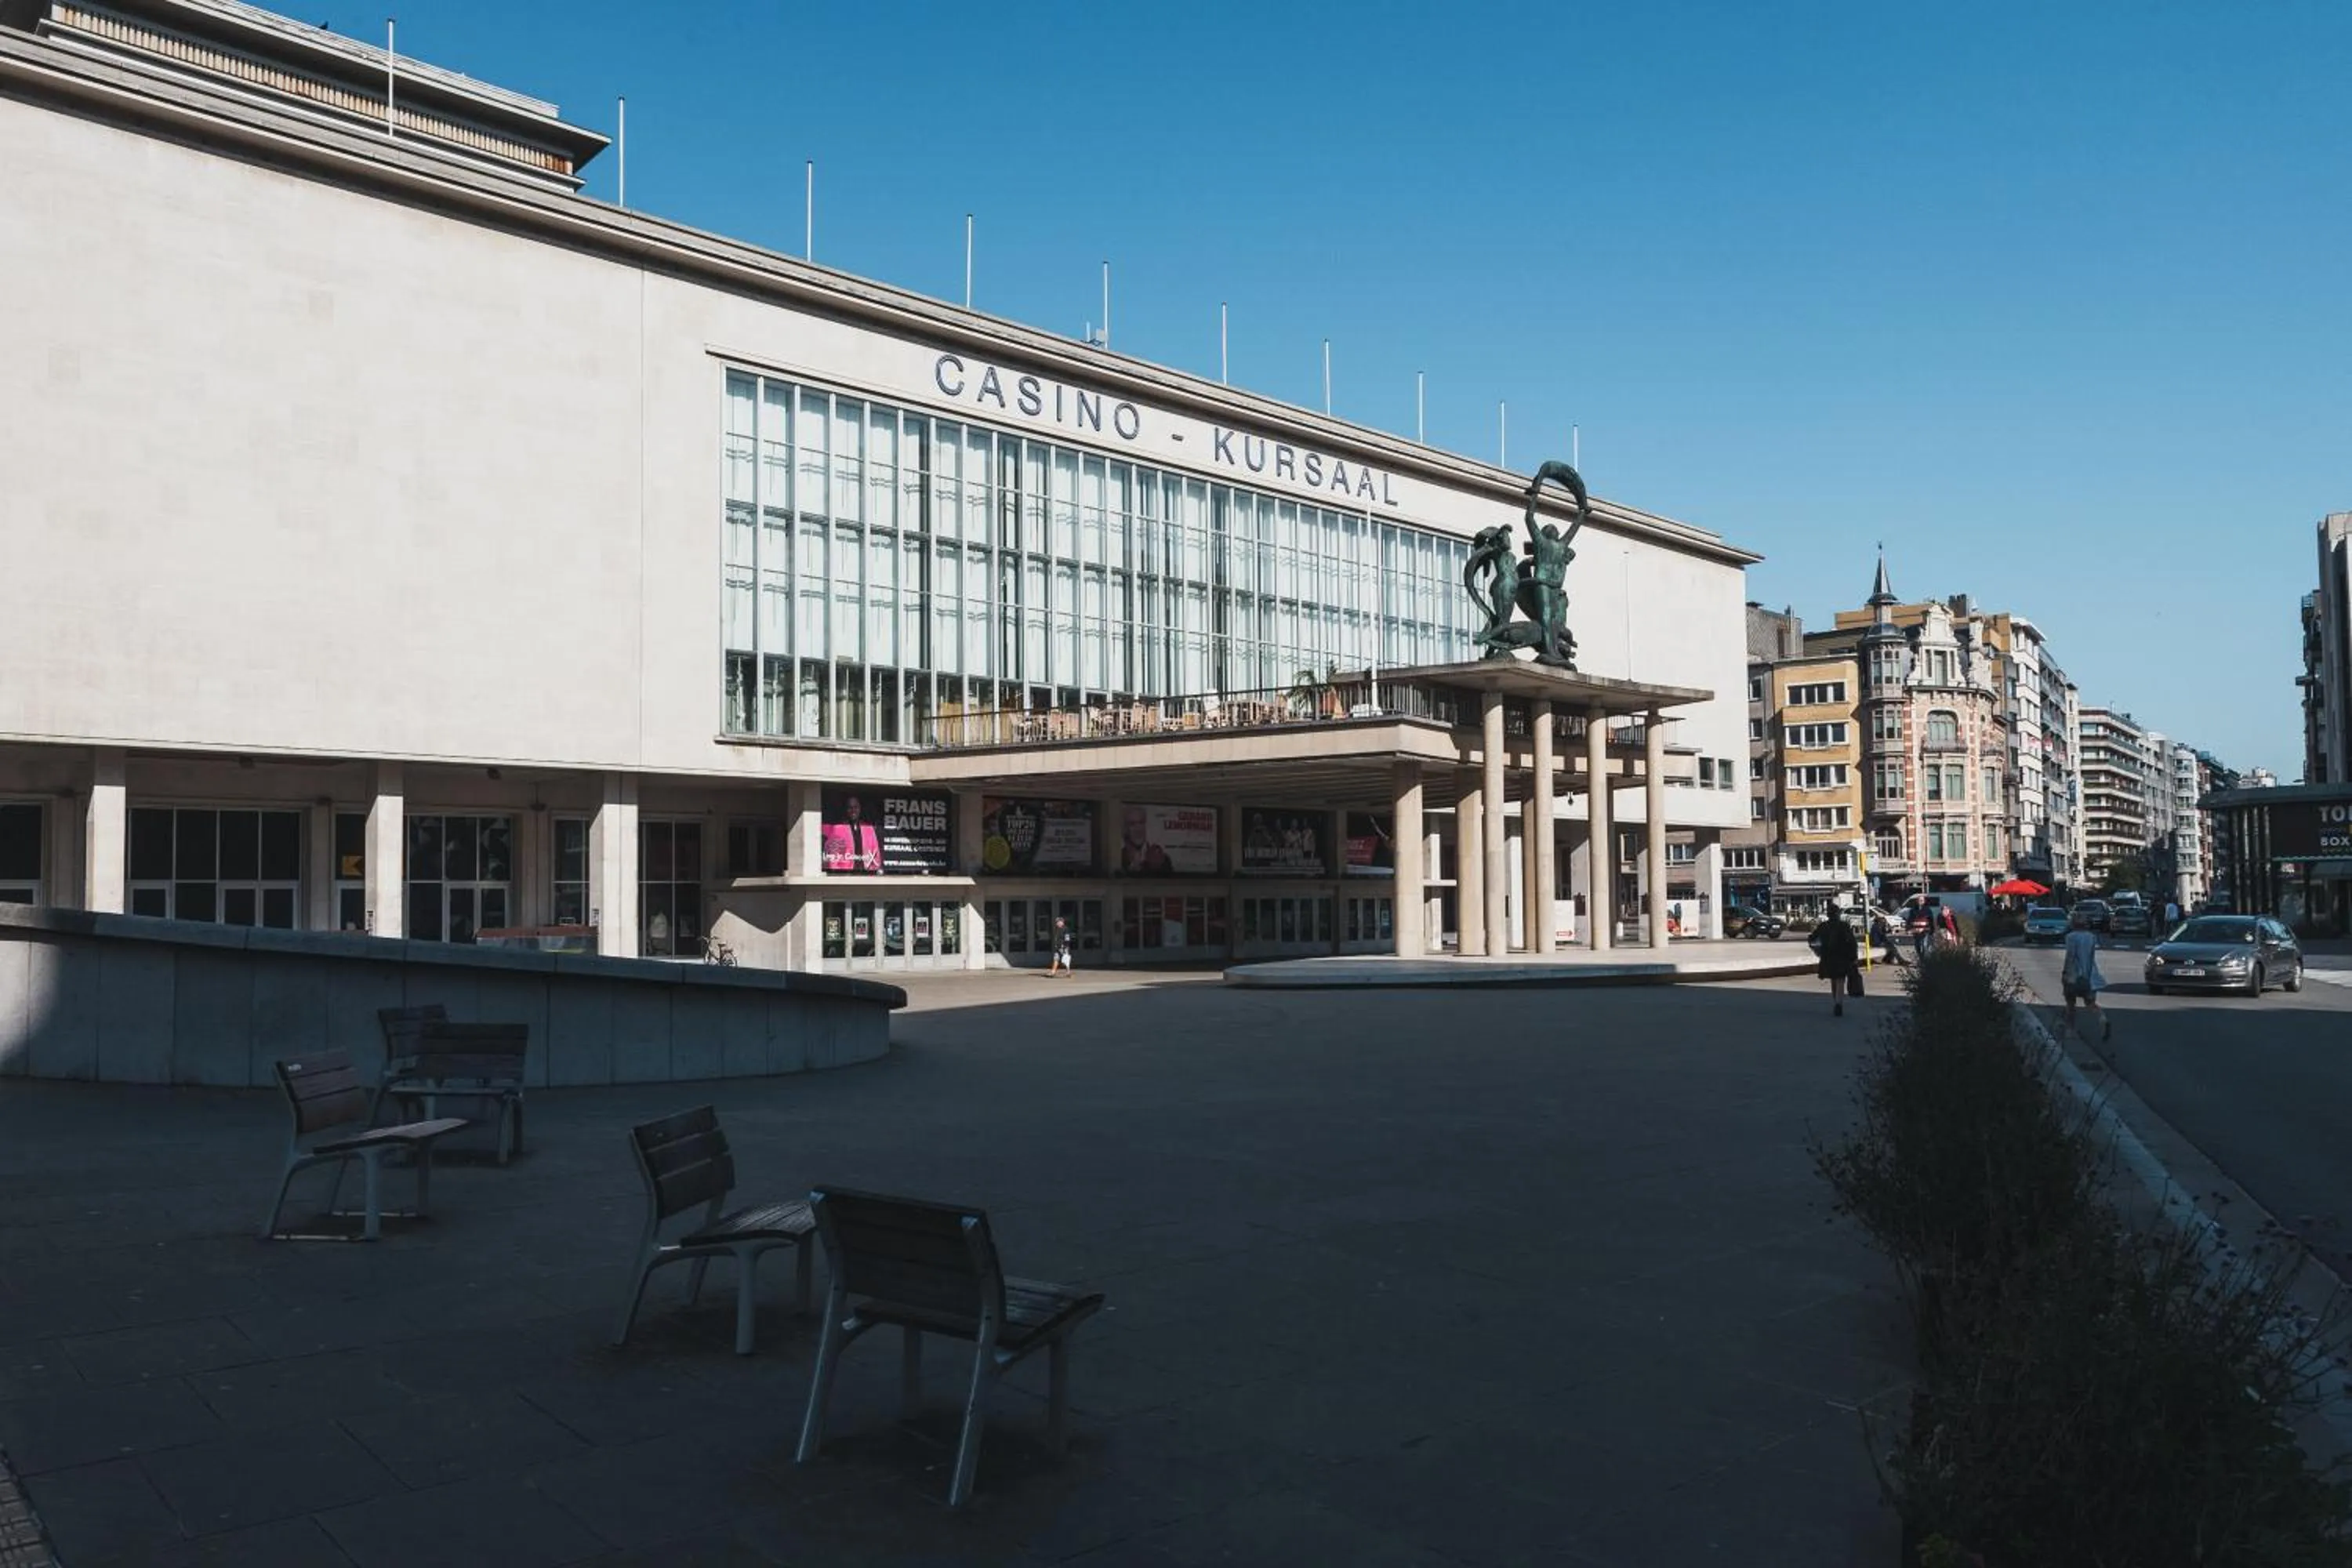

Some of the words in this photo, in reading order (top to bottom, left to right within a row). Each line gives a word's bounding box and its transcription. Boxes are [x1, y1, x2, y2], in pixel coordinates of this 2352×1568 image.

[934, 354, 1142, 441] CASINO
[1213, 426, 1400, 508] KURSAAL
[884, 798, 946, 815] FRANS
[884, 815, 947, 831] BAUER
[2320, 837, 2351, 846] BOX
